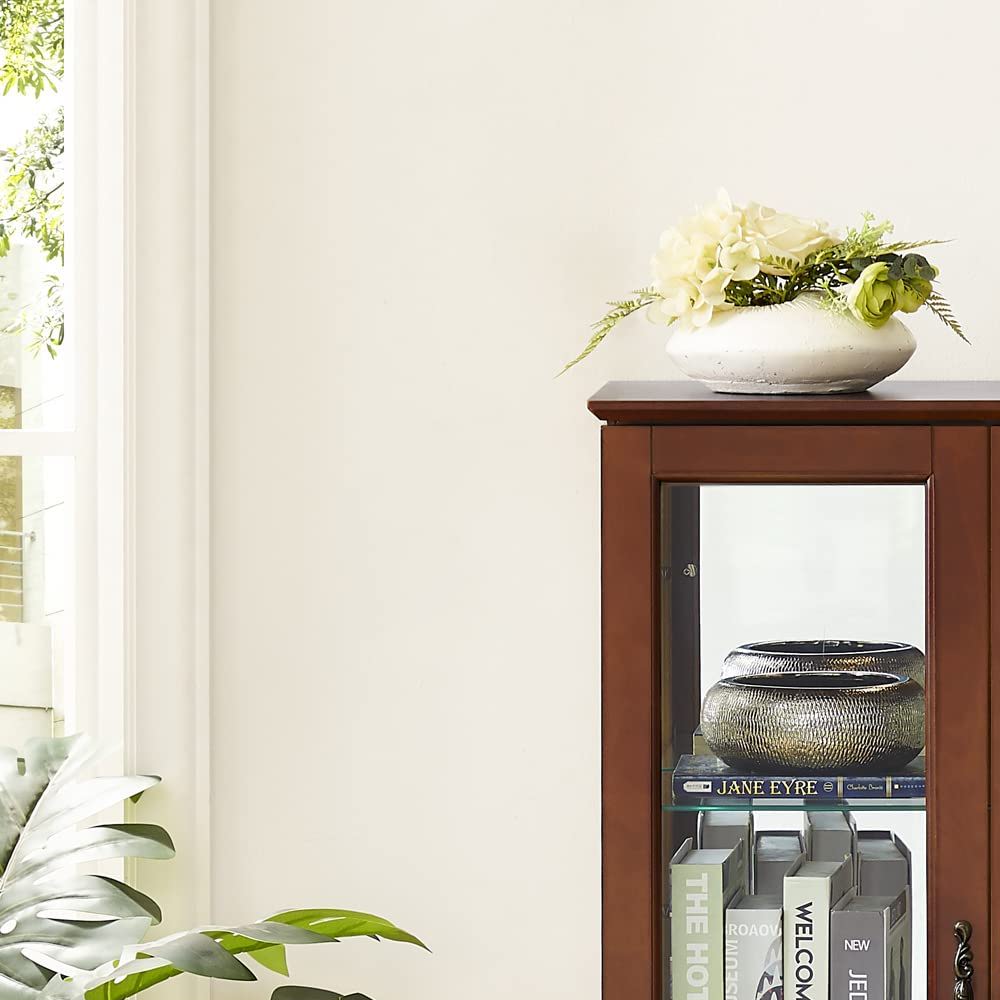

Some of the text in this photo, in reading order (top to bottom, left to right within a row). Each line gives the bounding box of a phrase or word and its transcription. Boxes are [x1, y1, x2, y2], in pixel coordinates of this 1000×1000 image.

[717, 780, 764, 795] JANE
[769, 778, 818, 796] EYRE
[686, 872, 709, 934] THE
[844, 939, 871, 951] NEW
